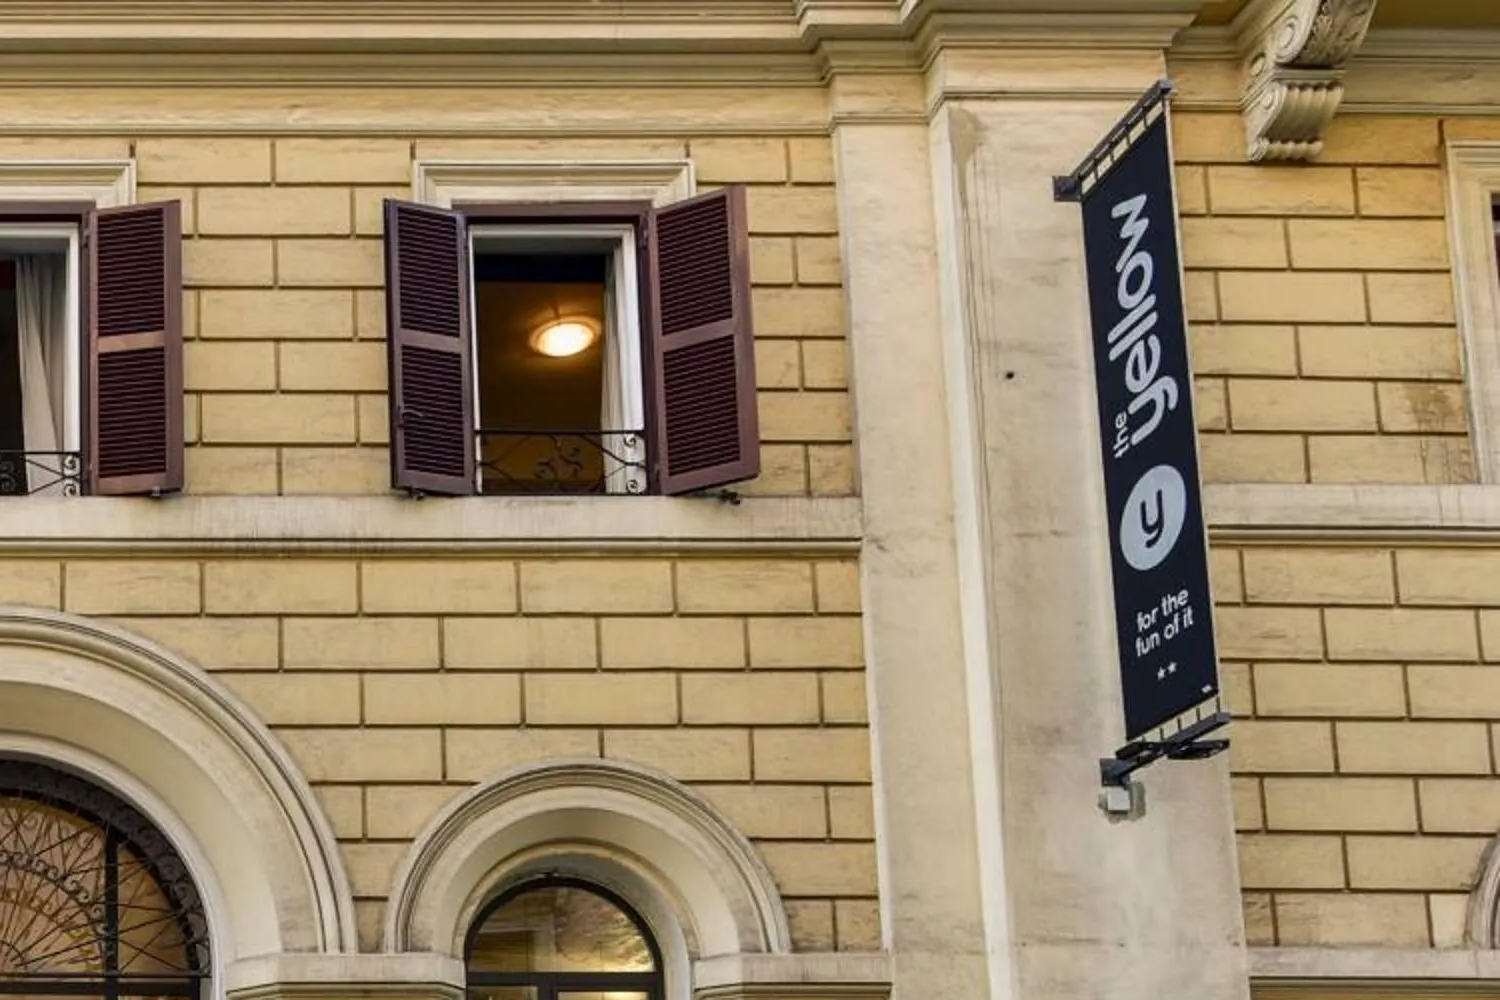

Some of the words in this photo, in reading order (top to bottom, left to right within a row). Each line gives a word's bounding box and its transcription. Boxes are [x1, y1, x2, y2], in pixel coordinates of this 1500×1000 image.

[1107, 193, 1179, 446] yellow
[1113, 411, 1131, 458] the
[1135, 631, 1160, 657] fun
[1164, 614, 1181, 641] of
[1182, 605, 1195, 627] it
[1136, 607, 1159, 633] for
[1161, 589, 1189, 618] the
